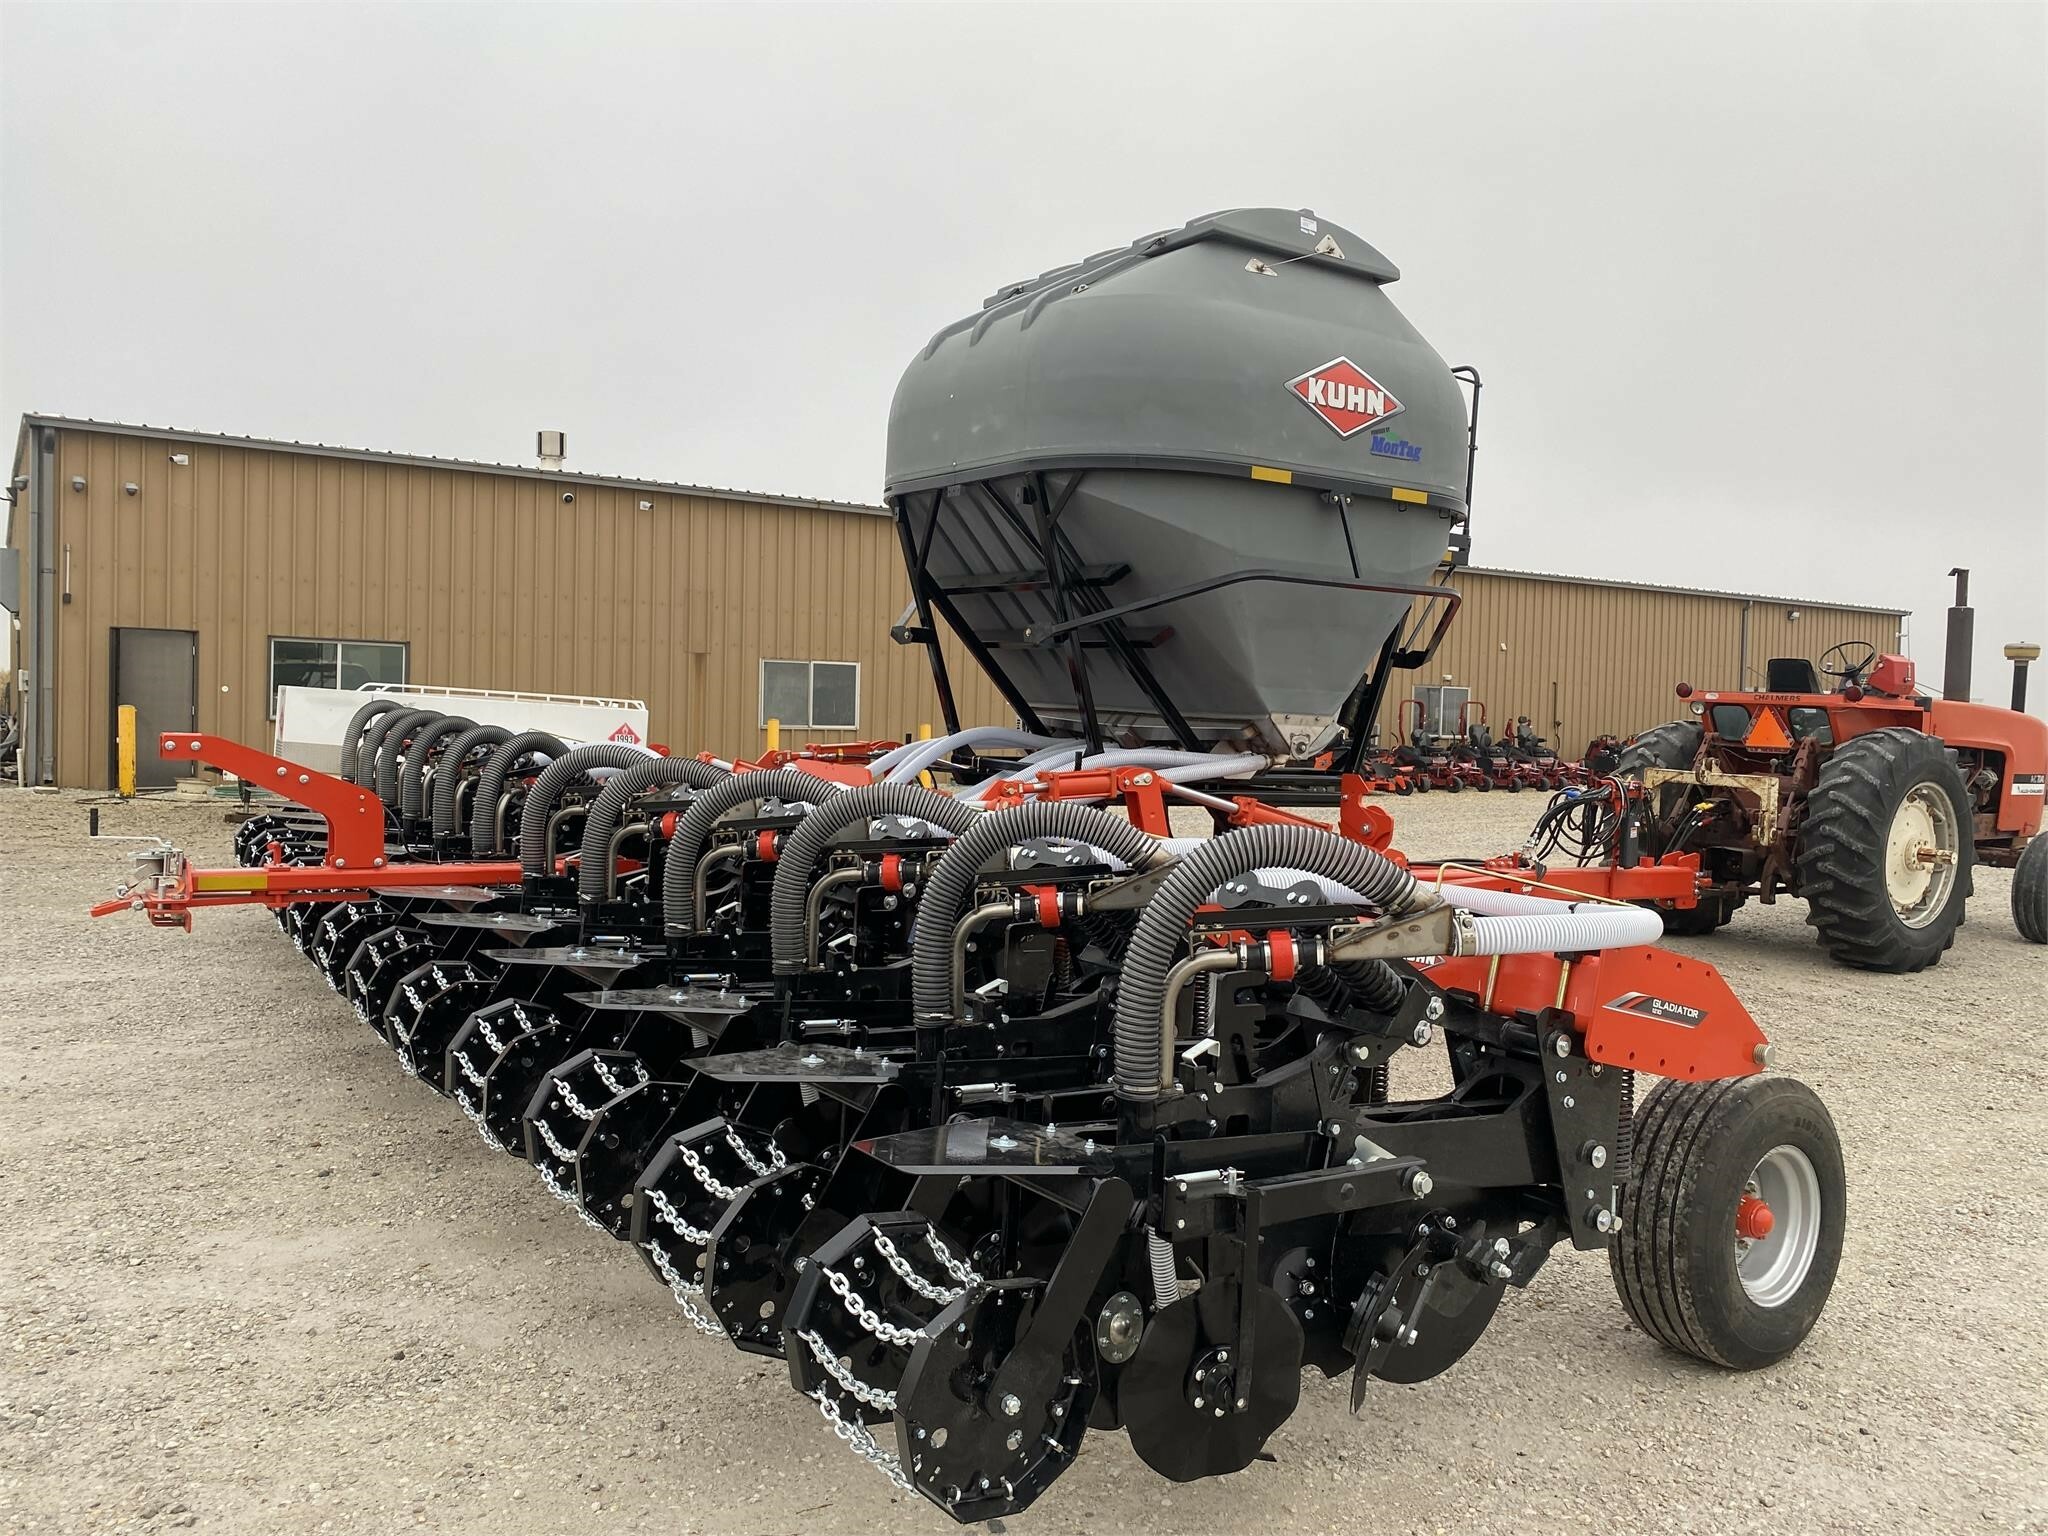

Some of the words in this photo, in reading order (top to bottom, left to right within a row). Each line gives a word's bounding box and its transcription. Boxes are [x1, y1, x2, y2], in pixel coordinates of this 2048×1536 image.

[1308, 376, 1385, 417] KUHN
[1371, 435, 1422, 462] MonTag
[1753, 694, 1801, 702] CHALMERS
[616, 734, 634, 744] 1993
[1652, 998, 1699, 1019] GLADIATOR
